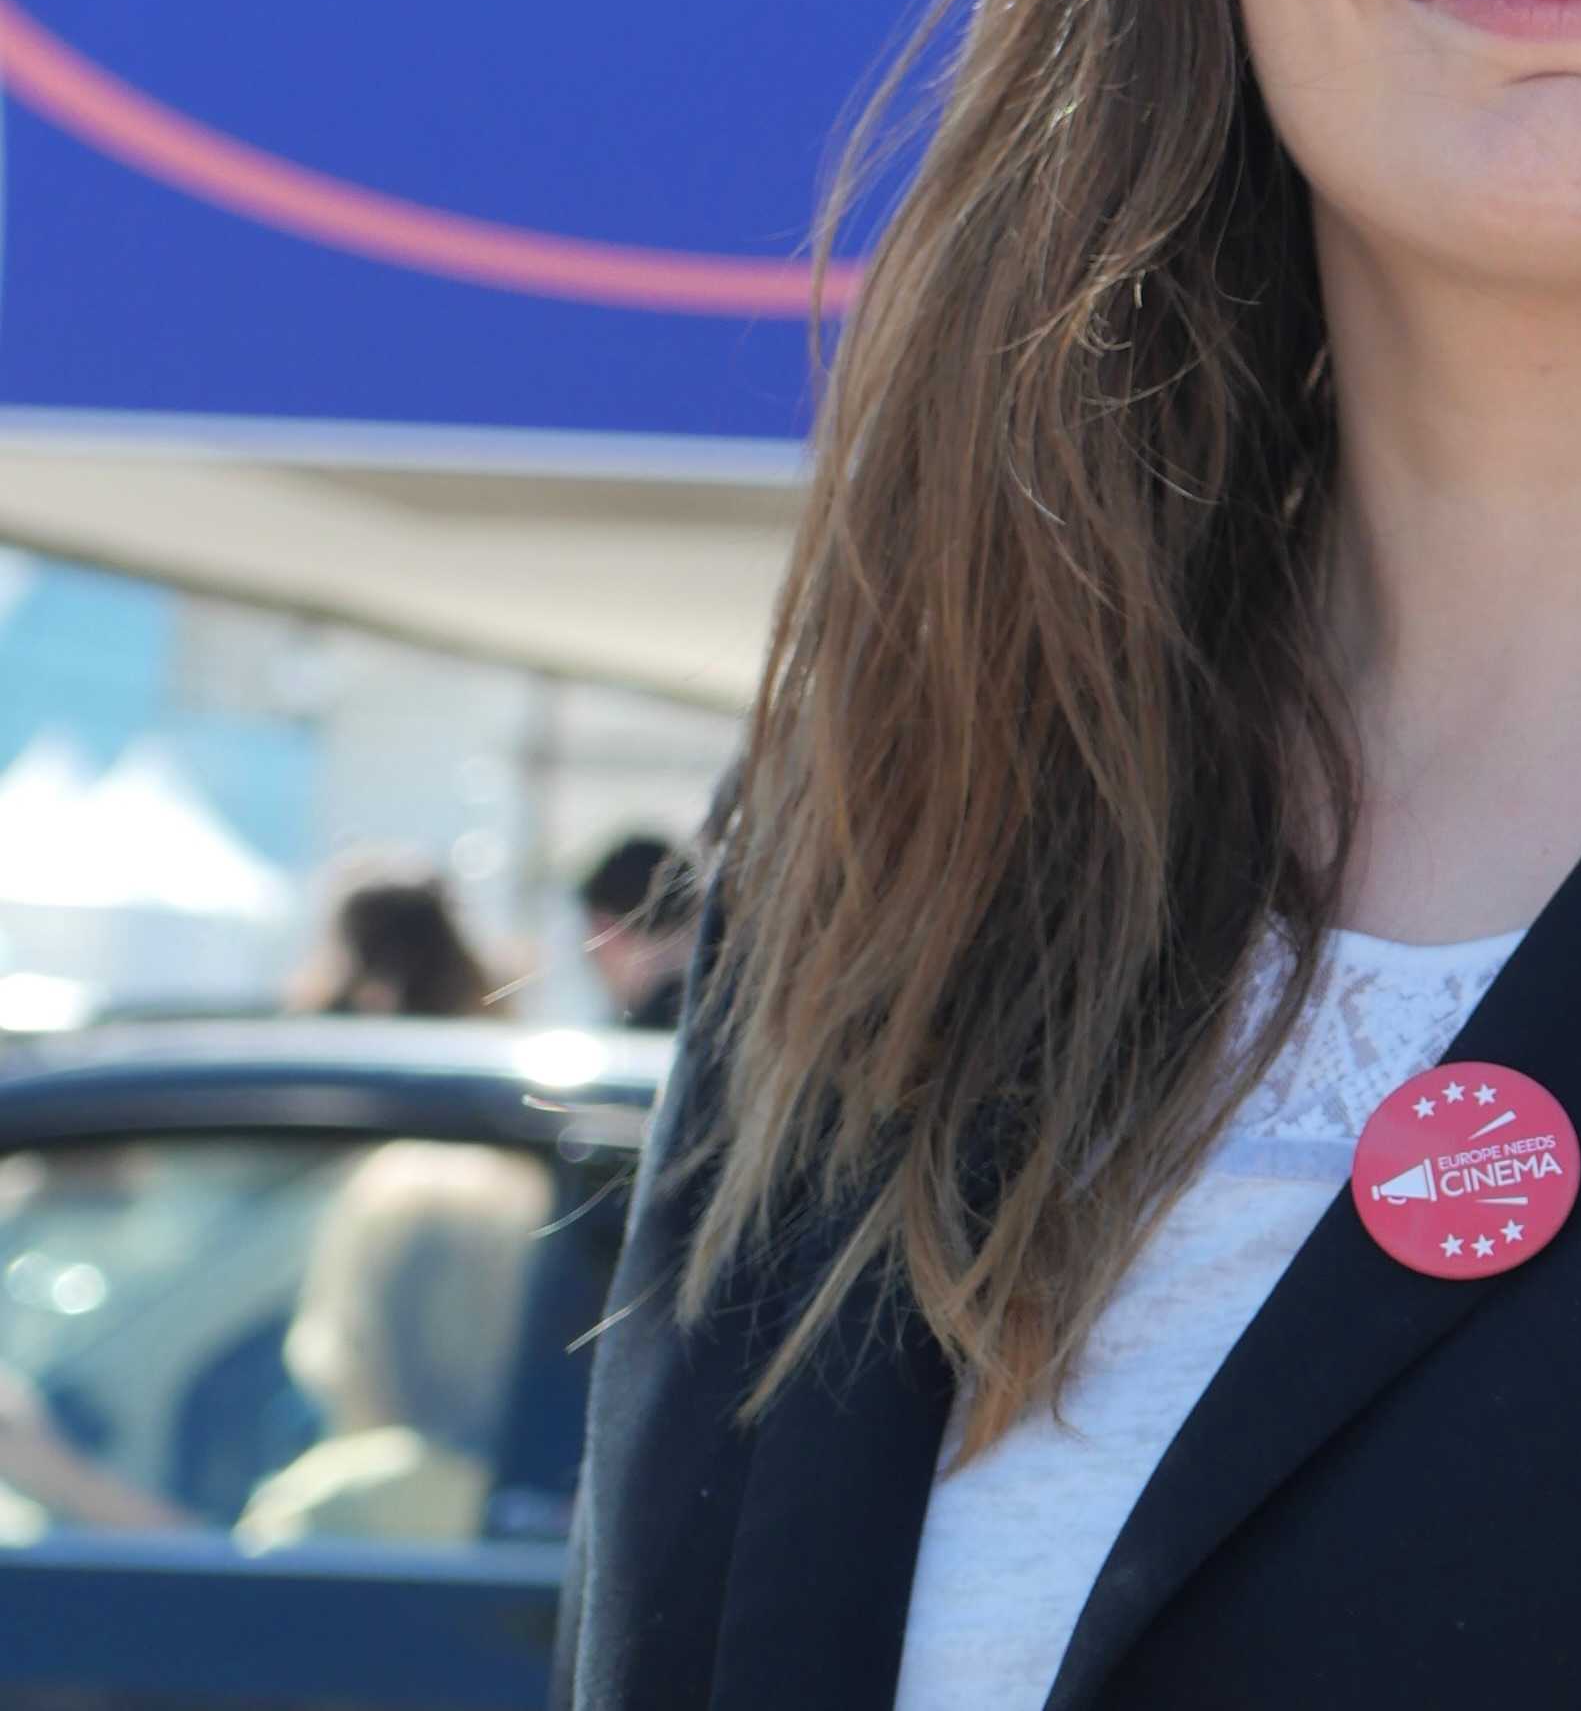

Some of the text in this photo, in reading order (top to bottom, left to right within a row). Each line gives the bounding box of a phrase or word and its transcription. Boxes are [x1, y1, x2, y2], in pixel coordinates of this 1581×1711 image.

[1439, 1136, 1556, 1169] EUROPE NEEDS
[1440, 1153, 1562, 1197] CINEMA
